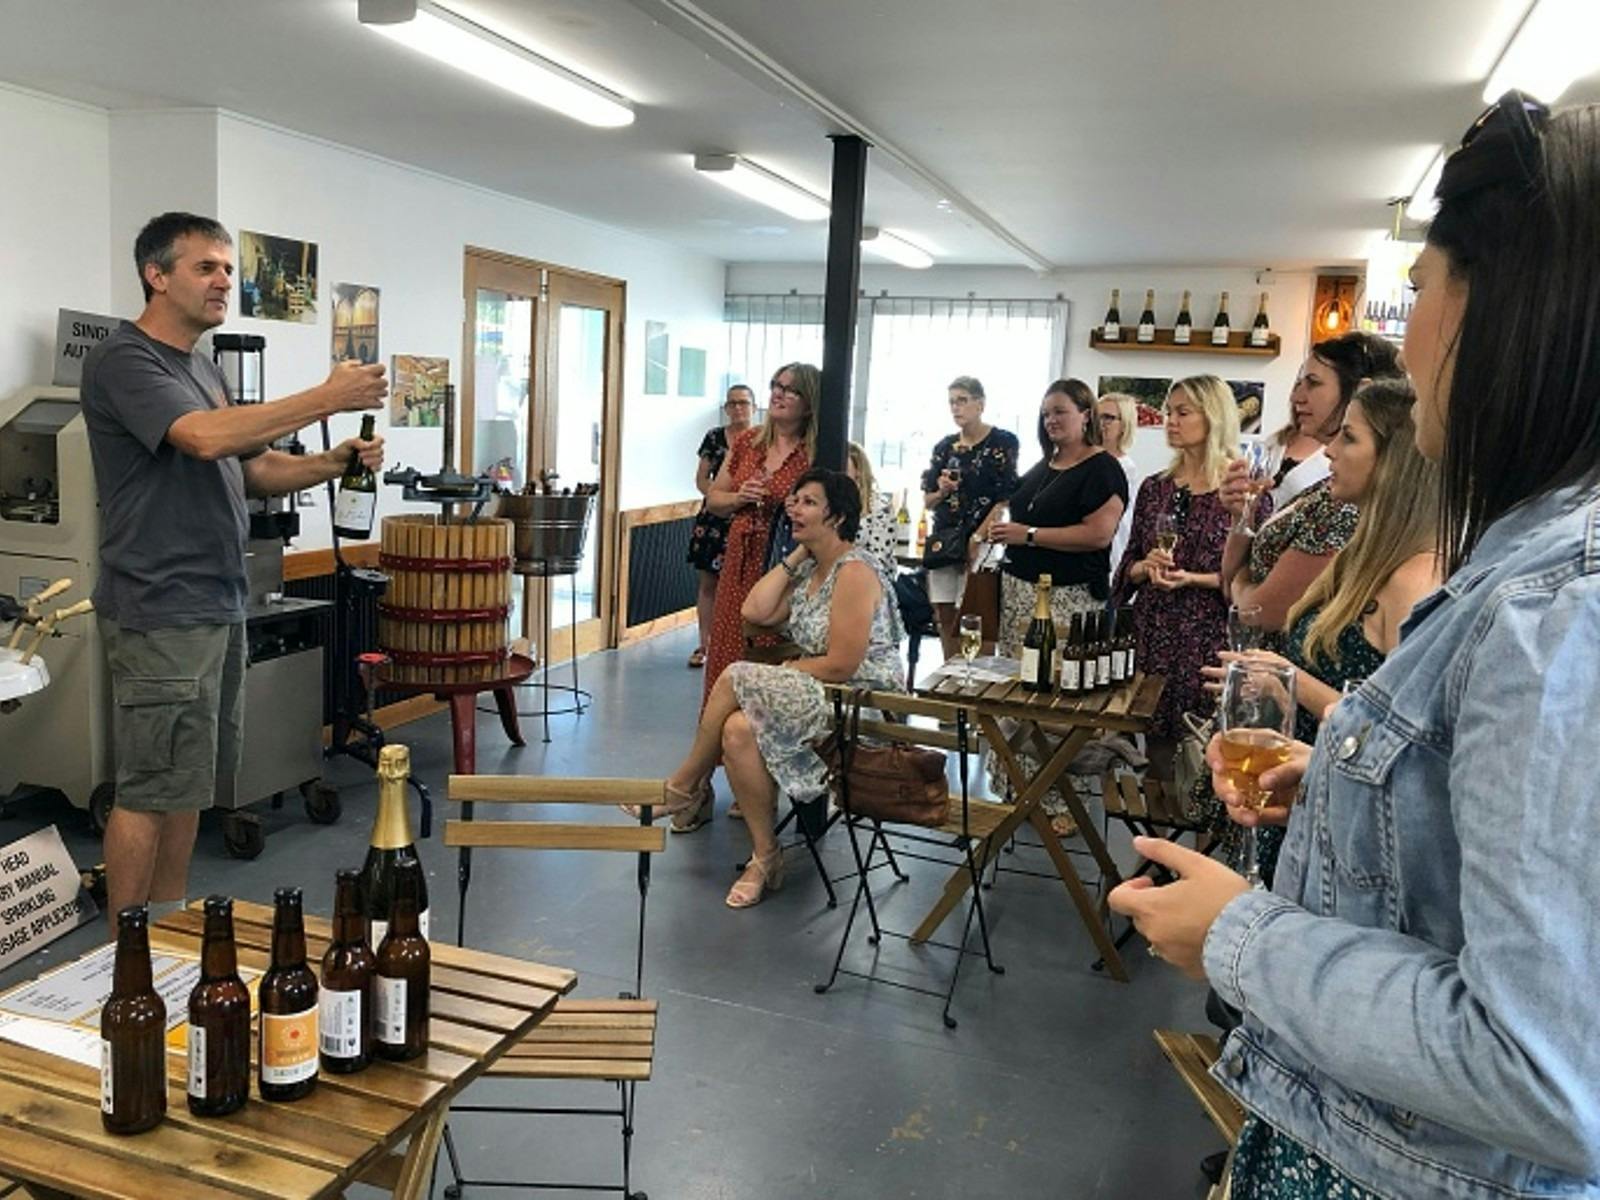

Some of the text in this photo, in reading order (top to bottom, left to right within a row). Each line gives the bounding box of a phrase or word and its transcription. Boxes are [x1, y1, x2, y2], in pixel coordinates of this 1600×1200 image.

[0, 852, 29, 873] HEAD
[14, 863, 59, 892] MANUAL
[1, 887, 56, 925] SPARKLING
[31, 899, 80, 936] APPLICATO
